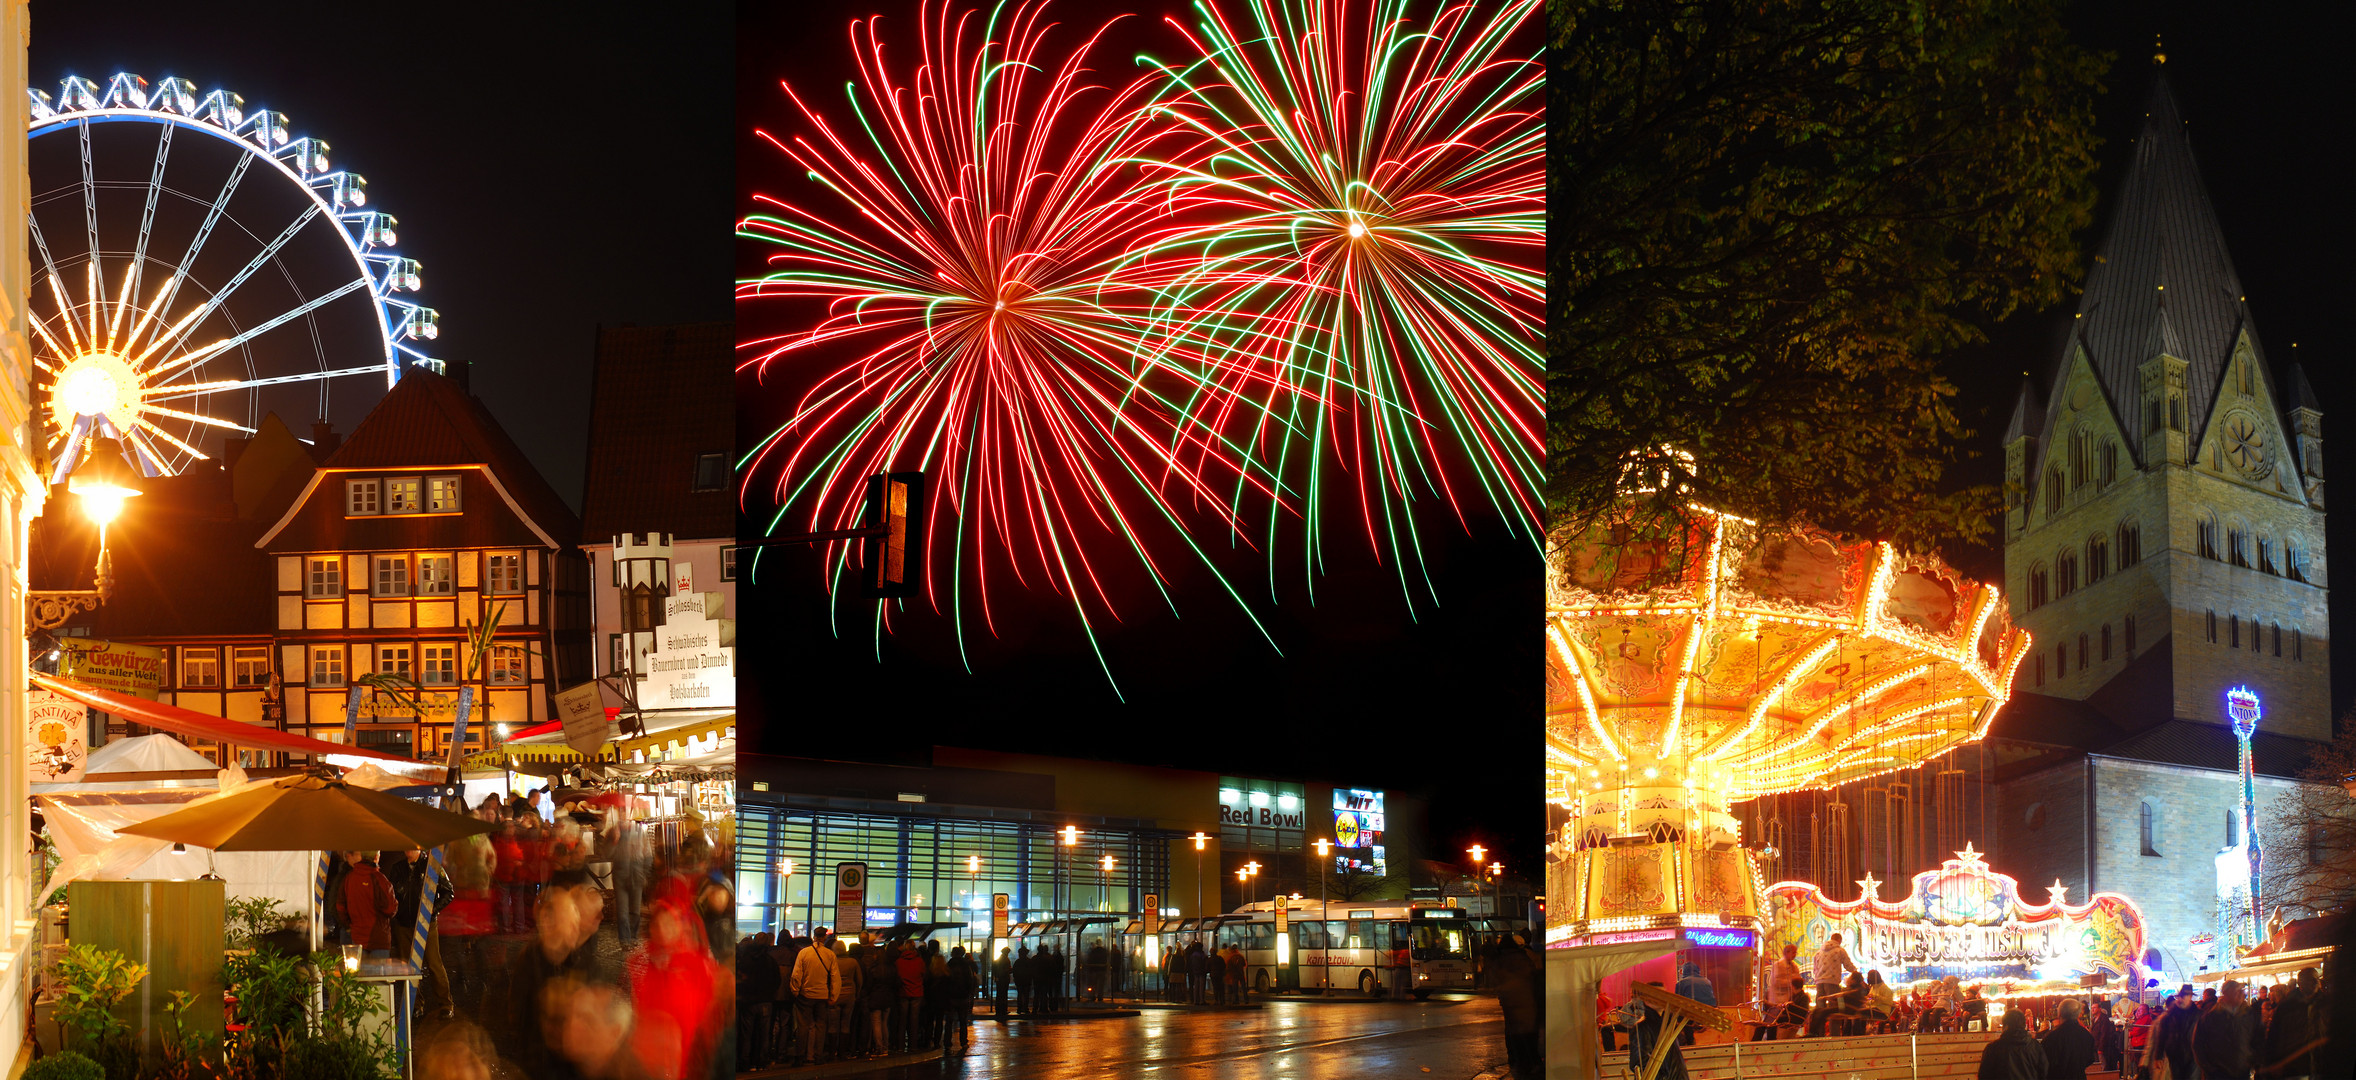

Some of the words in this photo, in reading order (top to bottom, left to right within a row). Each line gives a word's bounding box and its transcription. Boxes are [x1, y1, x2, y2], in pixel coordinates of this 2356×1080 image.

[668, 598, 703, 616] Schlossbeck
[89, 645, 159, 672] Gewürze
[687, 655, 699, 669] und
[88, 666, 107, 675] aus
[109, 668, 134, 678] aller
[134, 669, 158, 680] Welt
[120, 679, 132, 689] de
[132, 680, 158, 690] Linde
[29, 706, 78, 726] ANTINA
[1220, 804, 1253, 824] Red
[1260, 807, 1304, 828] Bowl
